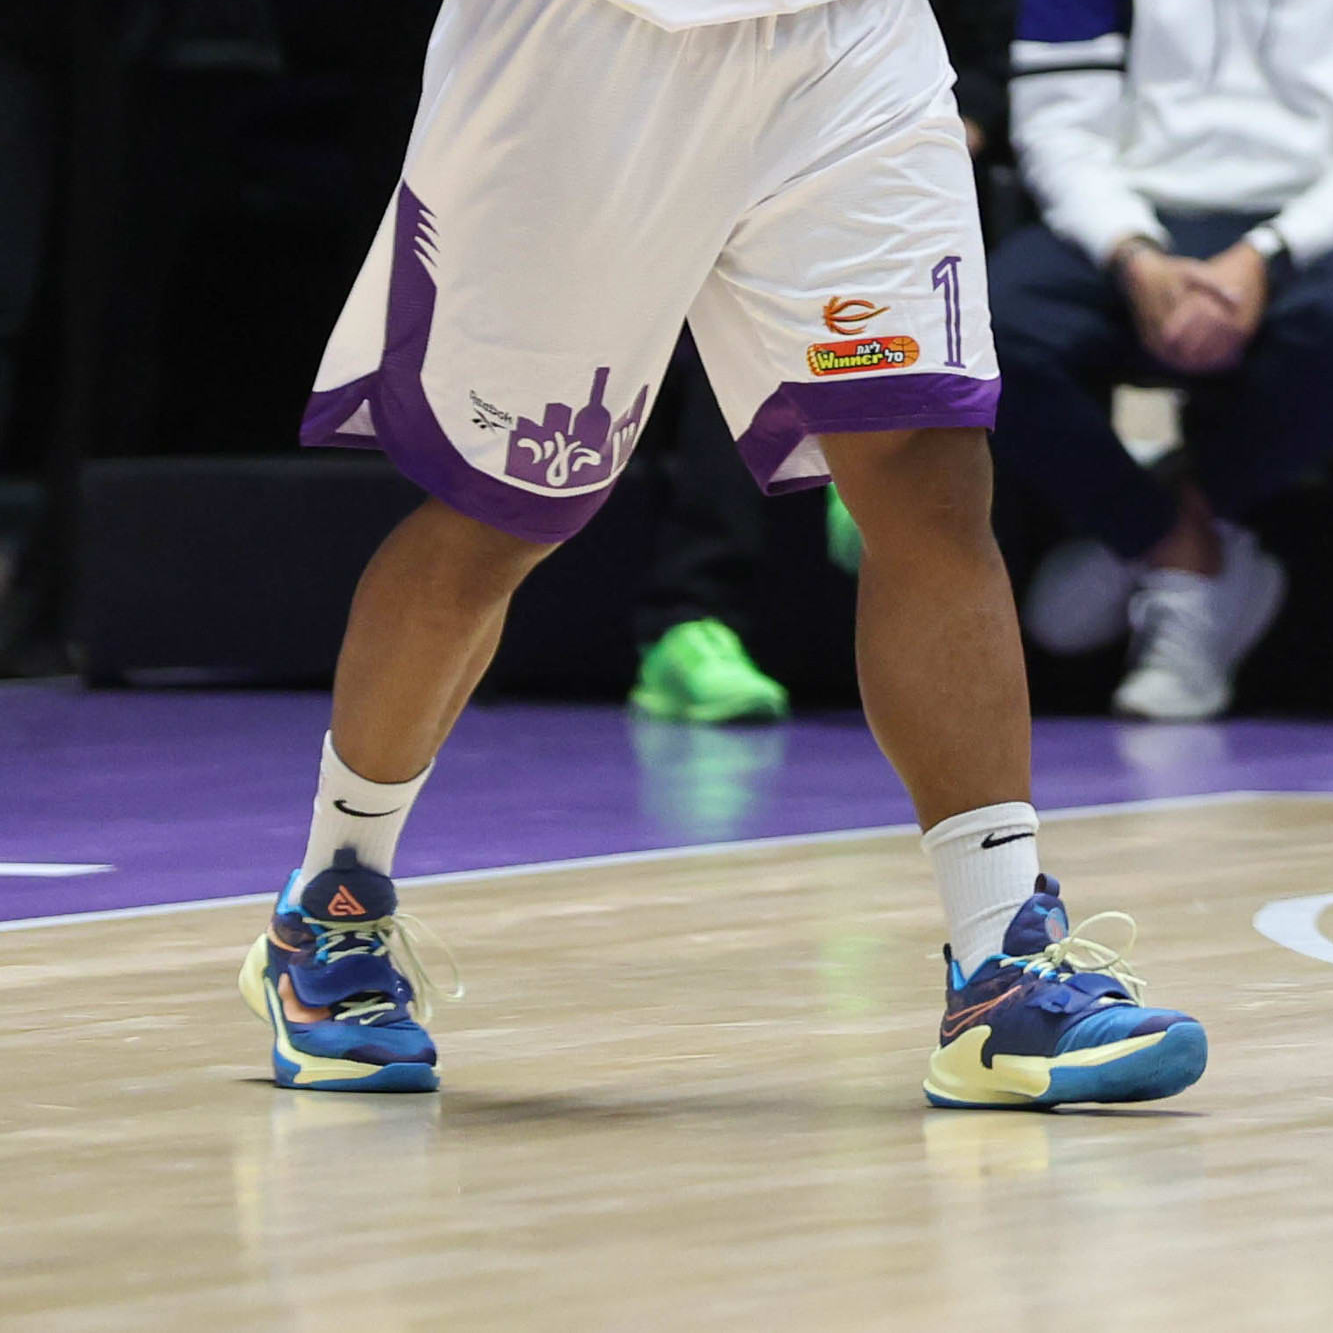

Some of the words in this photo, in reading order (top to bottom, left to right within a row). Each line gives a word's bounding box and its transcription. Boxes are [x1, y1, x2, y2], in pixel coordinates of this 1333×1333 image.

[931, 255, 967, 369] 1
[856, 340, 881, 355] ליגת
[884, 349, 904, 363] סל
[816, 351, 884, 370] Winner
